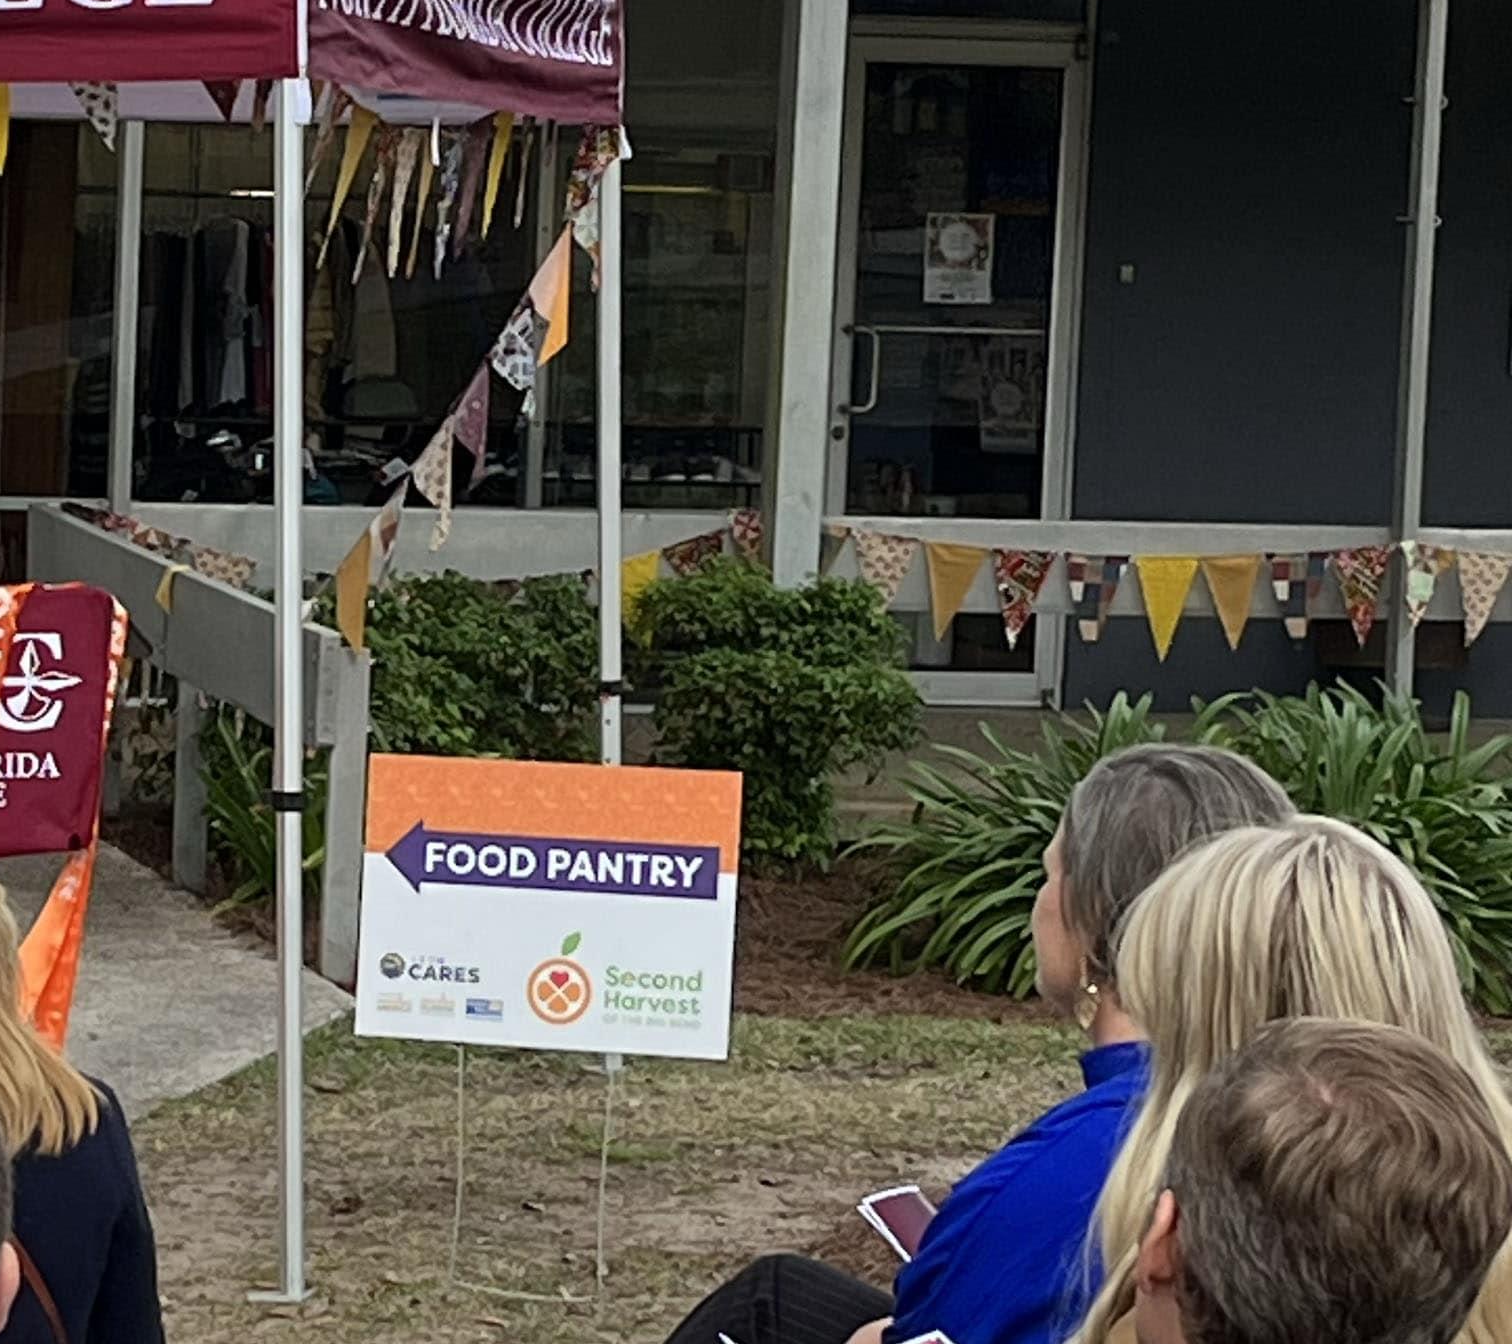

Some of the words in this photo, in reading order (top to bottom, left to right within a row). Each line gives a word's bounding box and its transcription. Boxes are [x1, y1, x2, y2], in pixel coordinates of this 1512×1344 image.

[424, 840, 537, 879] FOOD
[546, 848, 704, 889] PANTRY
[408, 963, 480, 983] CARES
[605, 965, 703, 992] Second
[603, 989, 701, 1015] Harvest
